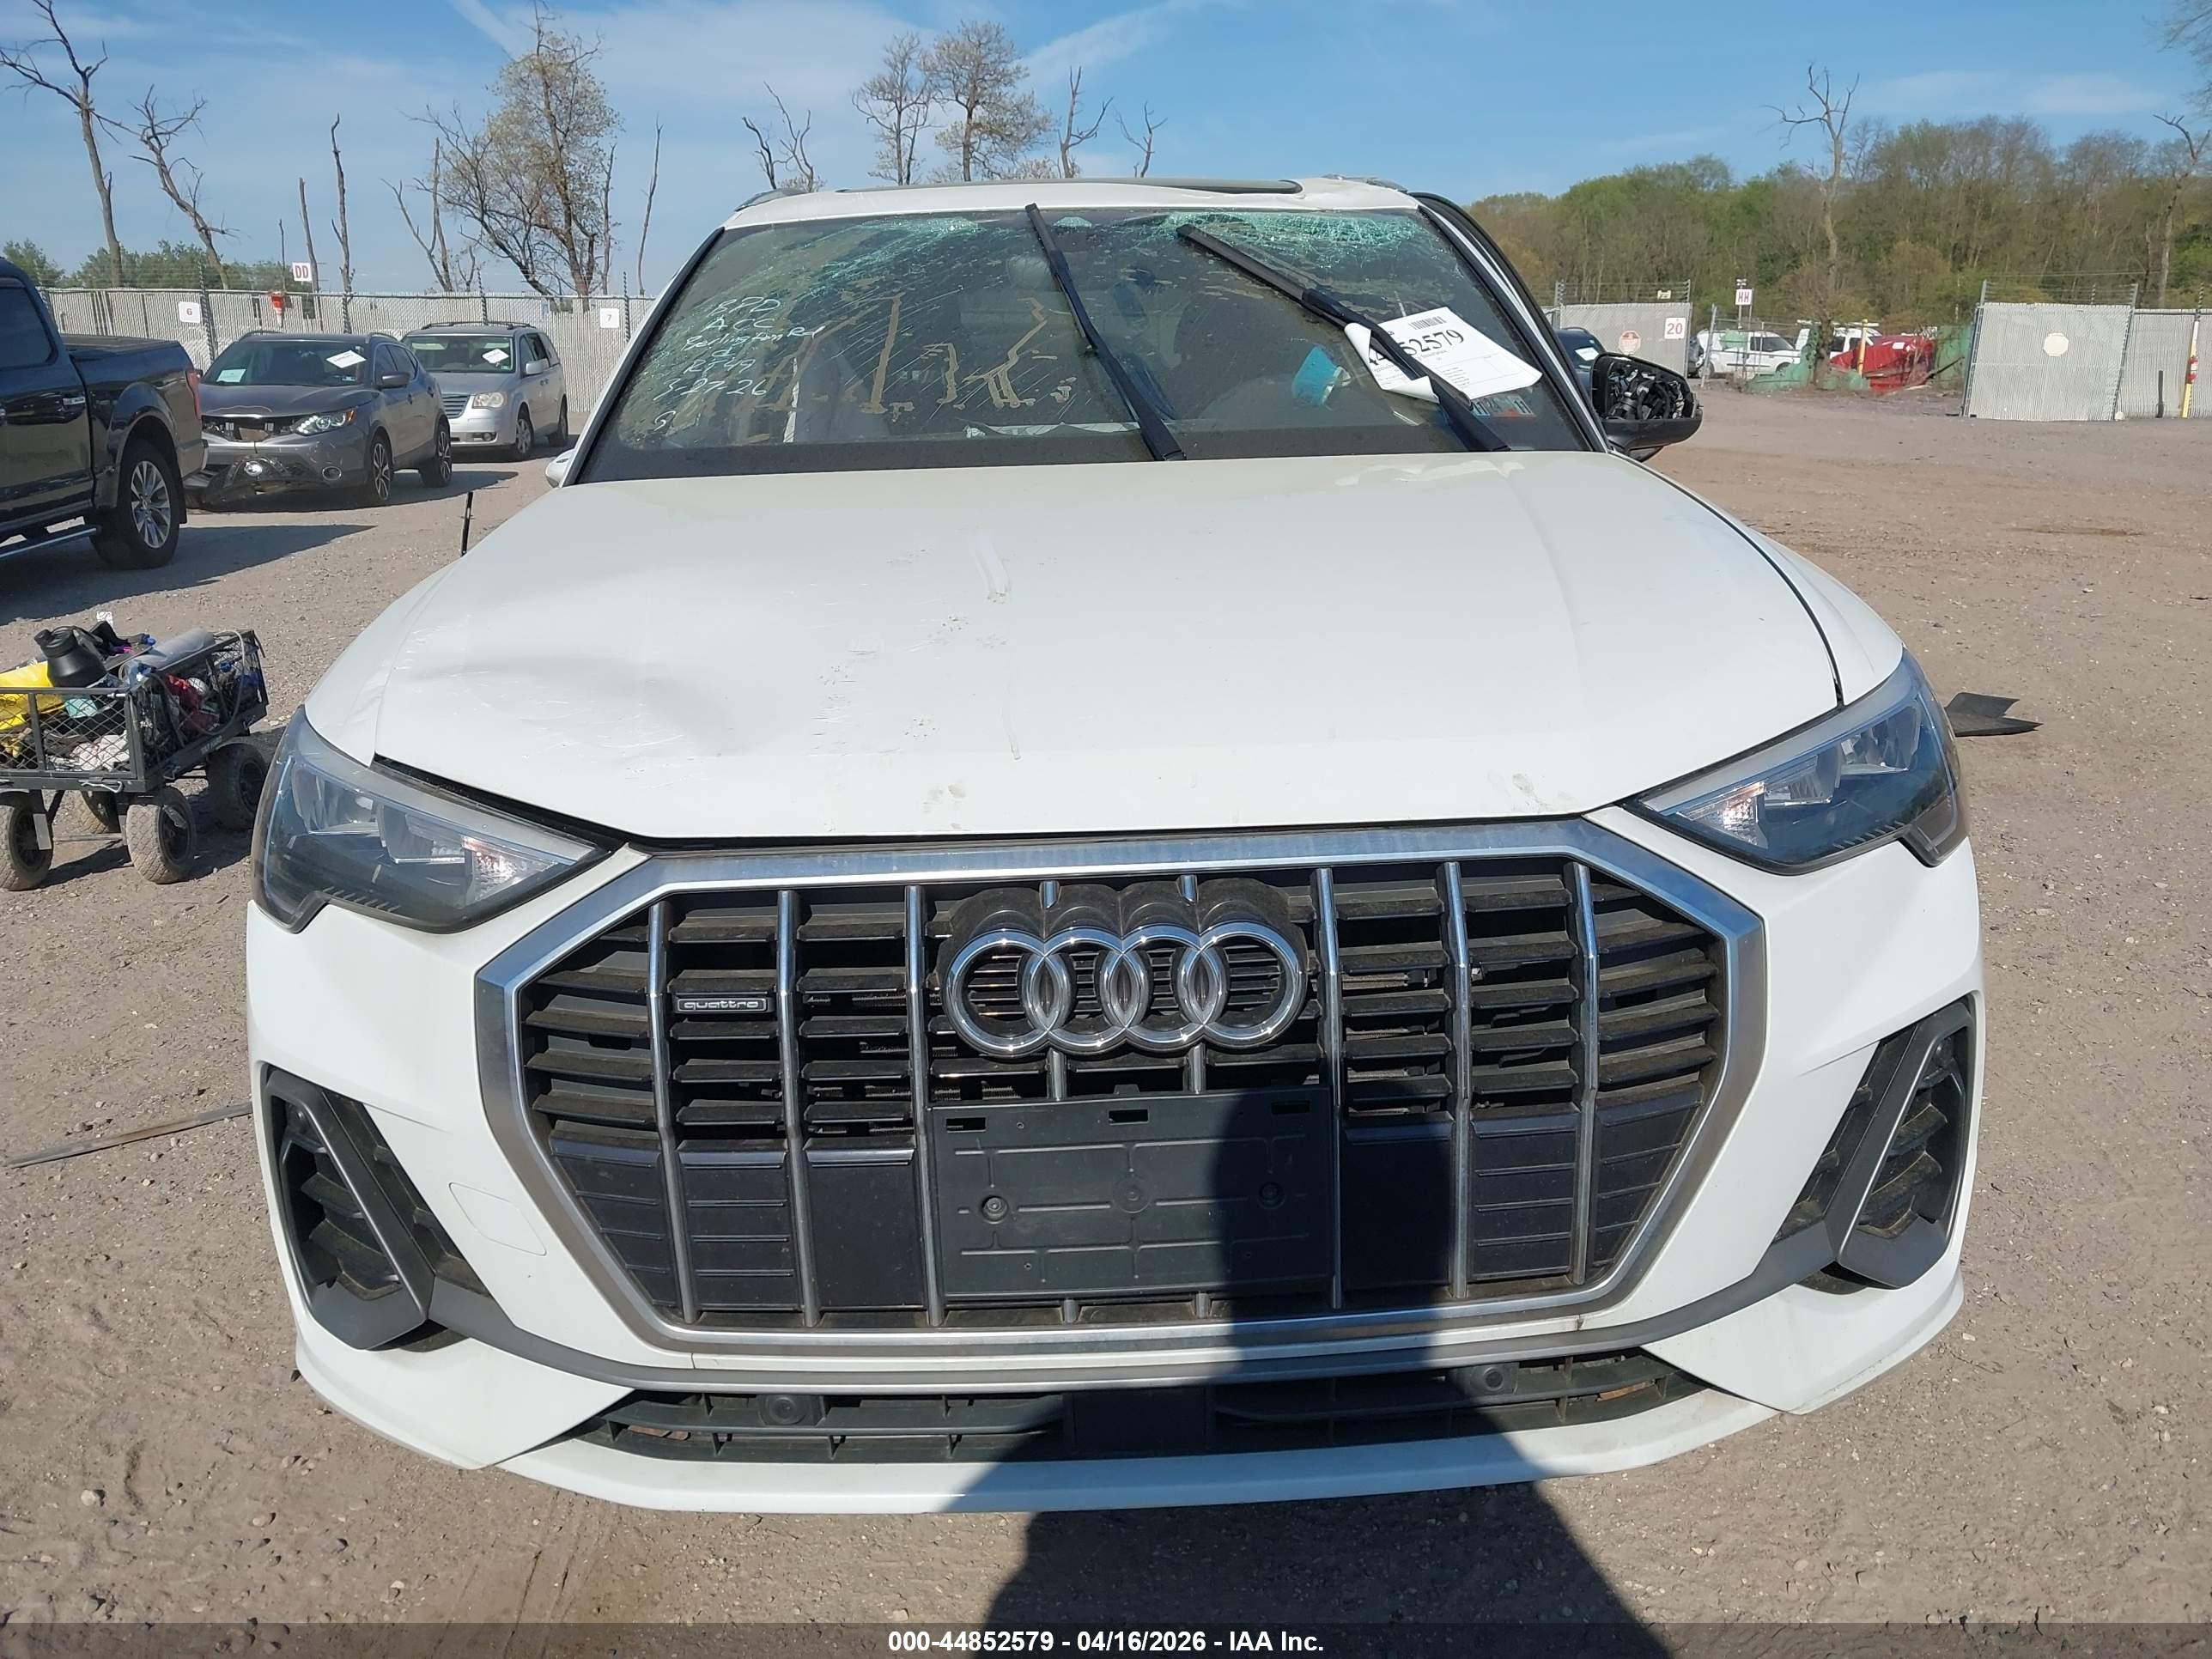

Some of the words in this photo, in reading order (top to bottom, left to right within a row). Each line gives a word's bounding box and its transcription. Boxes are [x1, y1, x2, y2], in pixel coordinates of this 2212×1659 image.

[295, 264, 309, 279] DD
[186, 307, 193, 316] 6
[1666, 322, 1683, 335] 20
[684, 1000, 759, 1011] quattro
